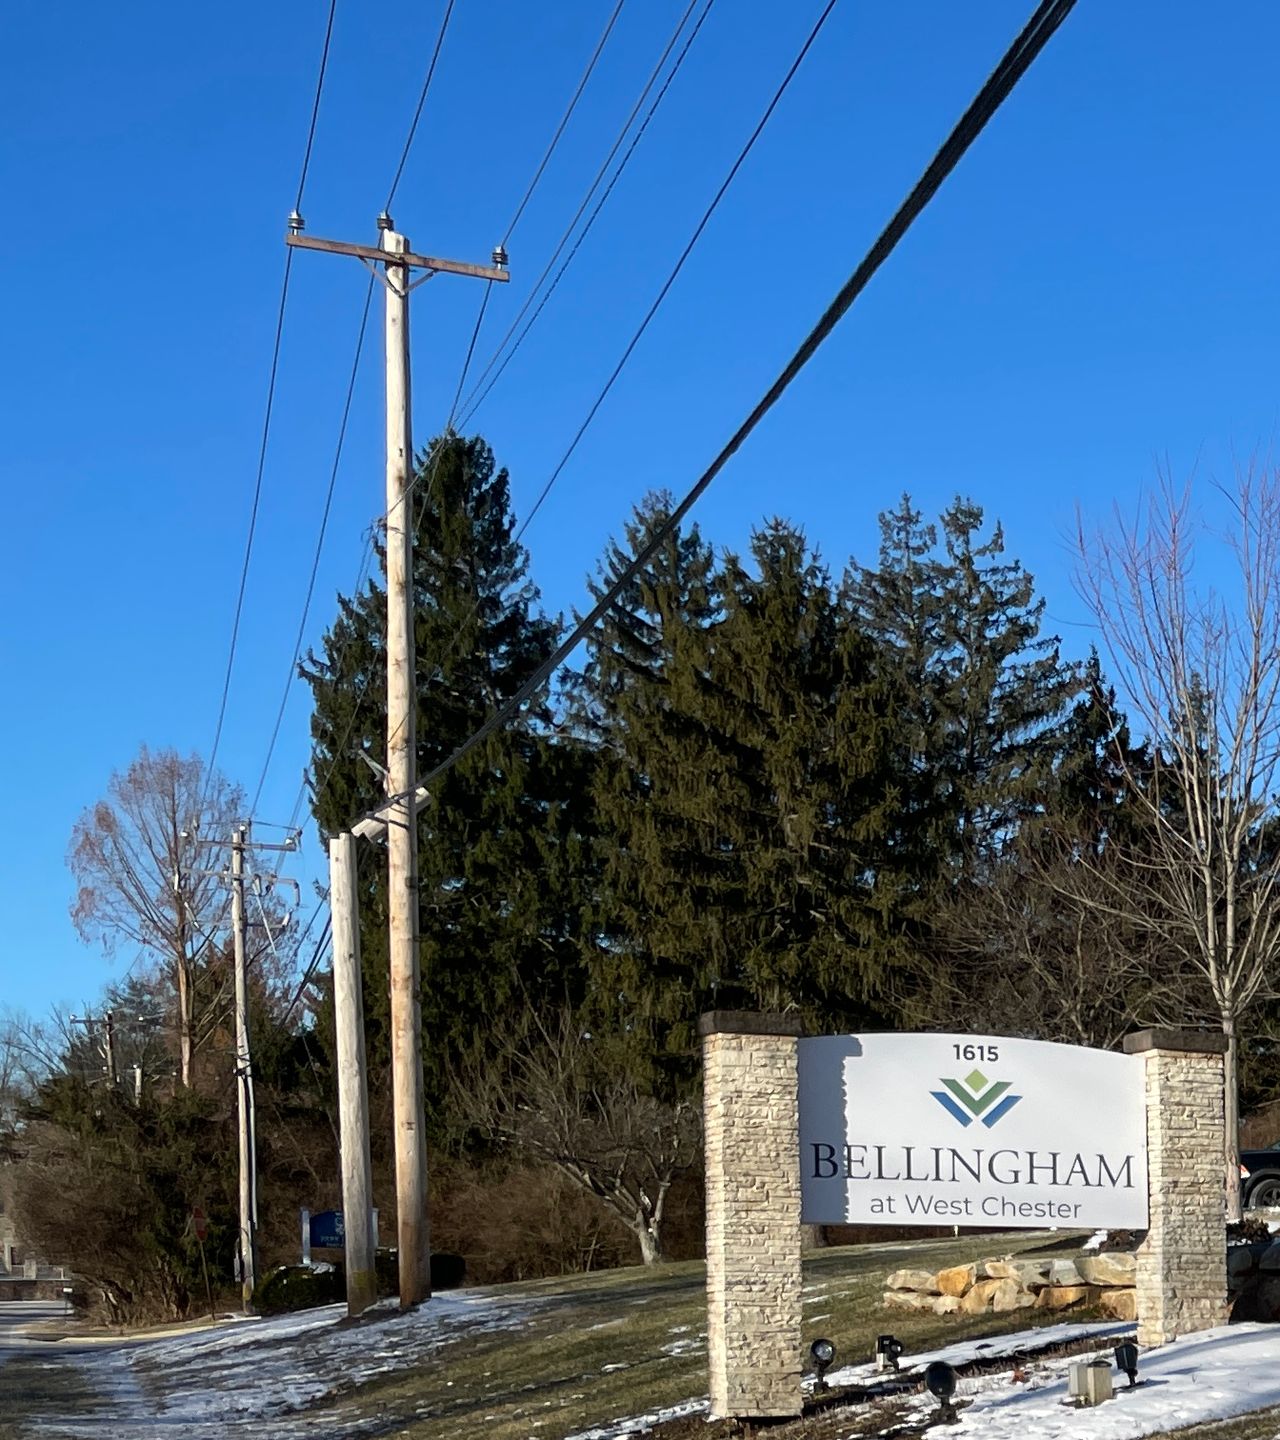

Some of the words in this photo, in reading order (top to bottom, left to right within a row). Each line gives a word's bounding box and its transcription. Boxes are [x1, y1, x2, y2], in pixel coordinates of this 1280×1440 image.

[953, 1044, 999, 1062] 1615
[811, 1142, 1135, 1188] BELLINGHAM
[870, 1195, 896, 1214] at
[904, 1193, 973, 1216] West
[981, 1196, 1082, 1218] Chester
